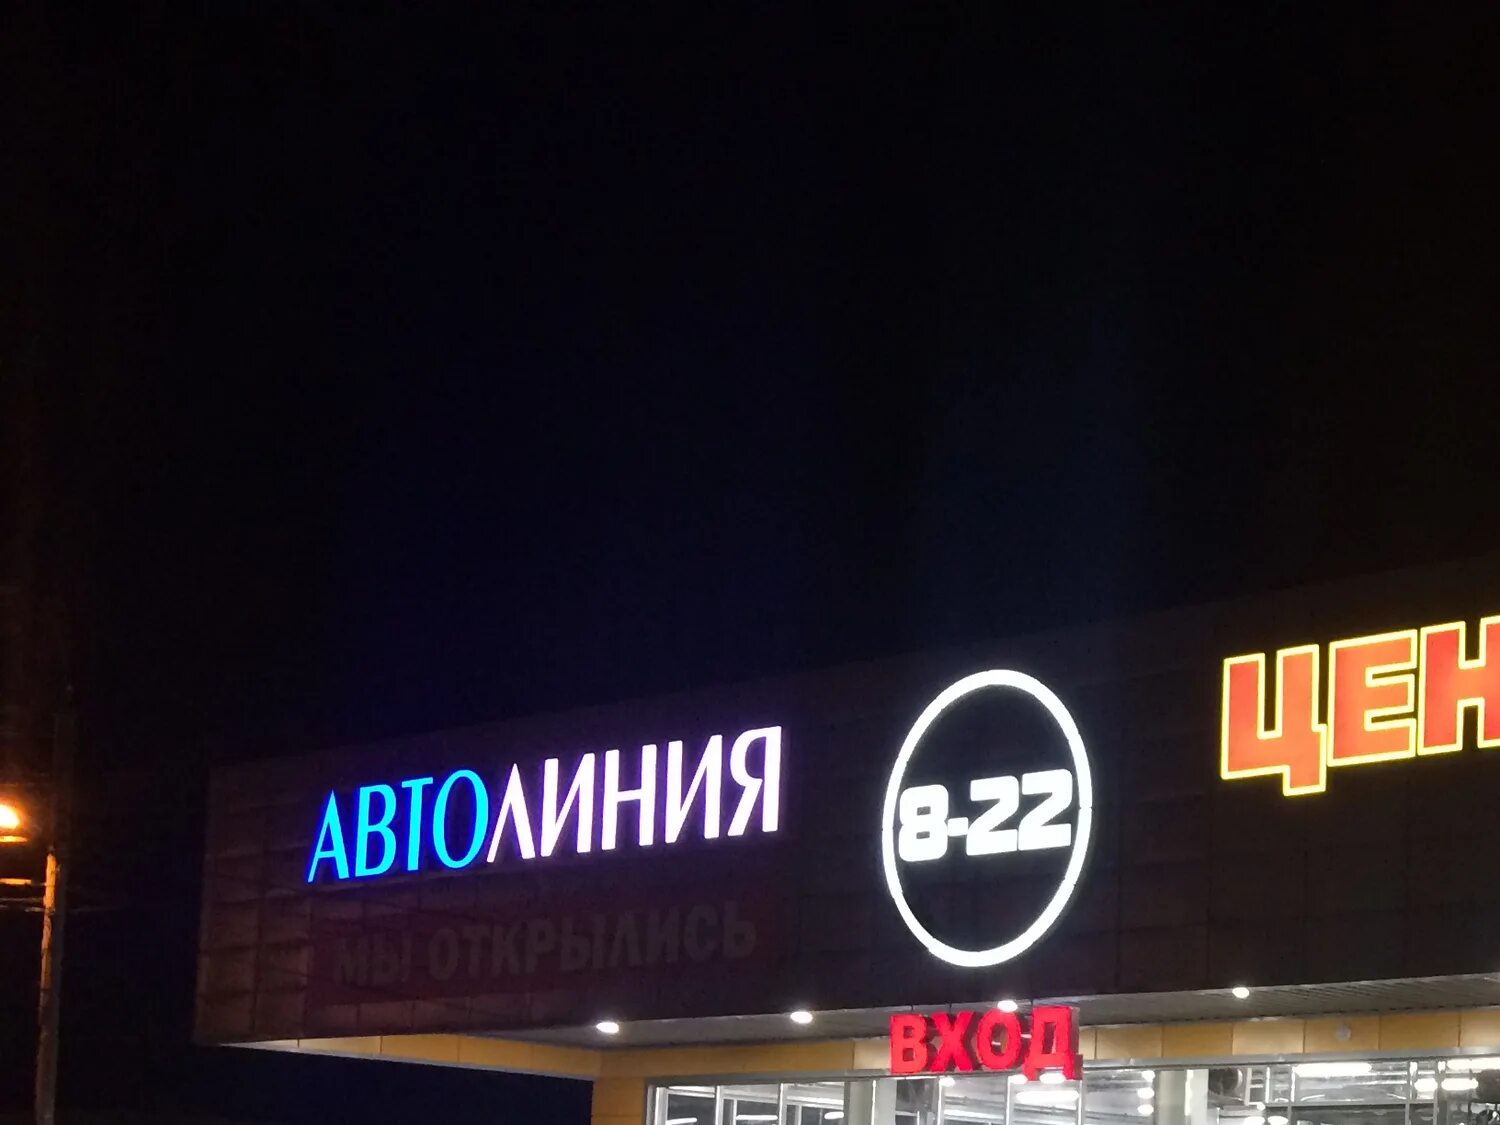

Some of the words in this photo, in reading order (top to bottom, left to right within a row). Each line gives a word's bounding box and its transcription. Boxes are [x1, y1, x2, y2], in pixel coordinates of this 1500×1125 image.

[307, 723, 783, 884] АВТОЛИНИЯ
[897, 768, 1074, 863] 8-22
[335, 929, 409, 987] МЫ
[428, 902, 758, 981] ОТКРЫЛИСЬ
[889, 1004, 1083, 1082] ВХОД
